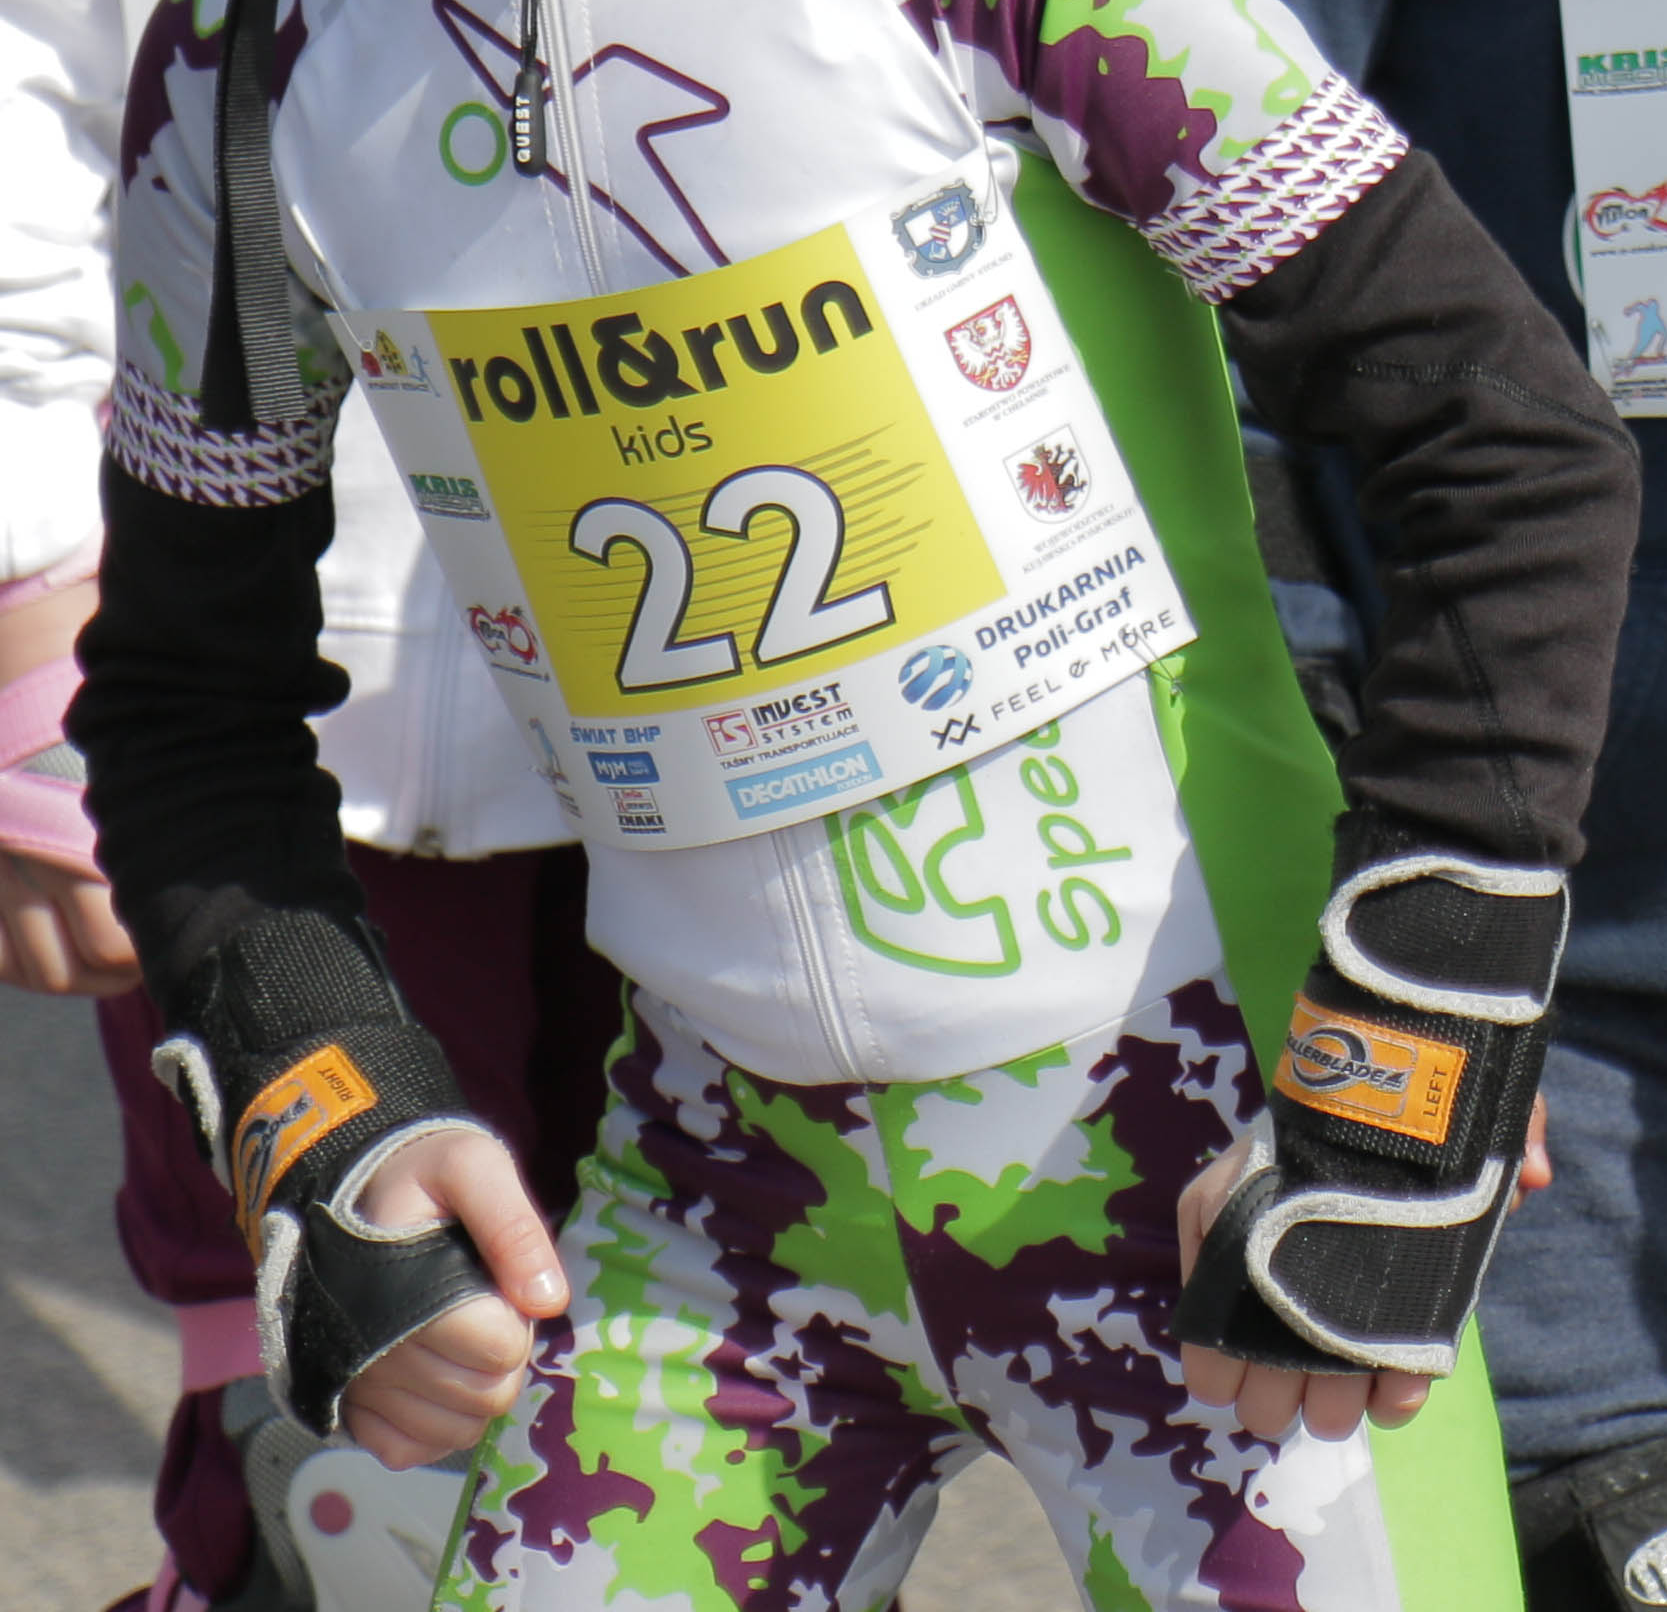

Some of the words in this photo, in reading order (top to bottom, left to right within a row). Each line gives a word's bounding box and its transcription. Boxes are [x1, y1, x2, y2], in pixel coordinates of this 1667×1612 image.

[515, 93, 532, 164] QUEST
[448, 280, 873, 425] roll&run
[611, 416, 713, 466] kids
[568, 464, 897, 696] 22
[975, 546, 1145, 650] DRUKARNIA
[1013, 586, 1133, 669] Poli-Graf
[991, 677, 1062, 721] FEEL
[1100, 609, 1176, 663] MORE
[751, 683, 842, 726] INVEST
[761, 706, 854, 744] SYSTEM
[570, 721, 617, 744] ŚWIAT
[623, 726, 661, 744] BHP
[737, 754, 870, 809] DECATHLON
[318, 1067, 355, 1103] RIGHT
[1423, 1068, 1448, 1117] LEFT
